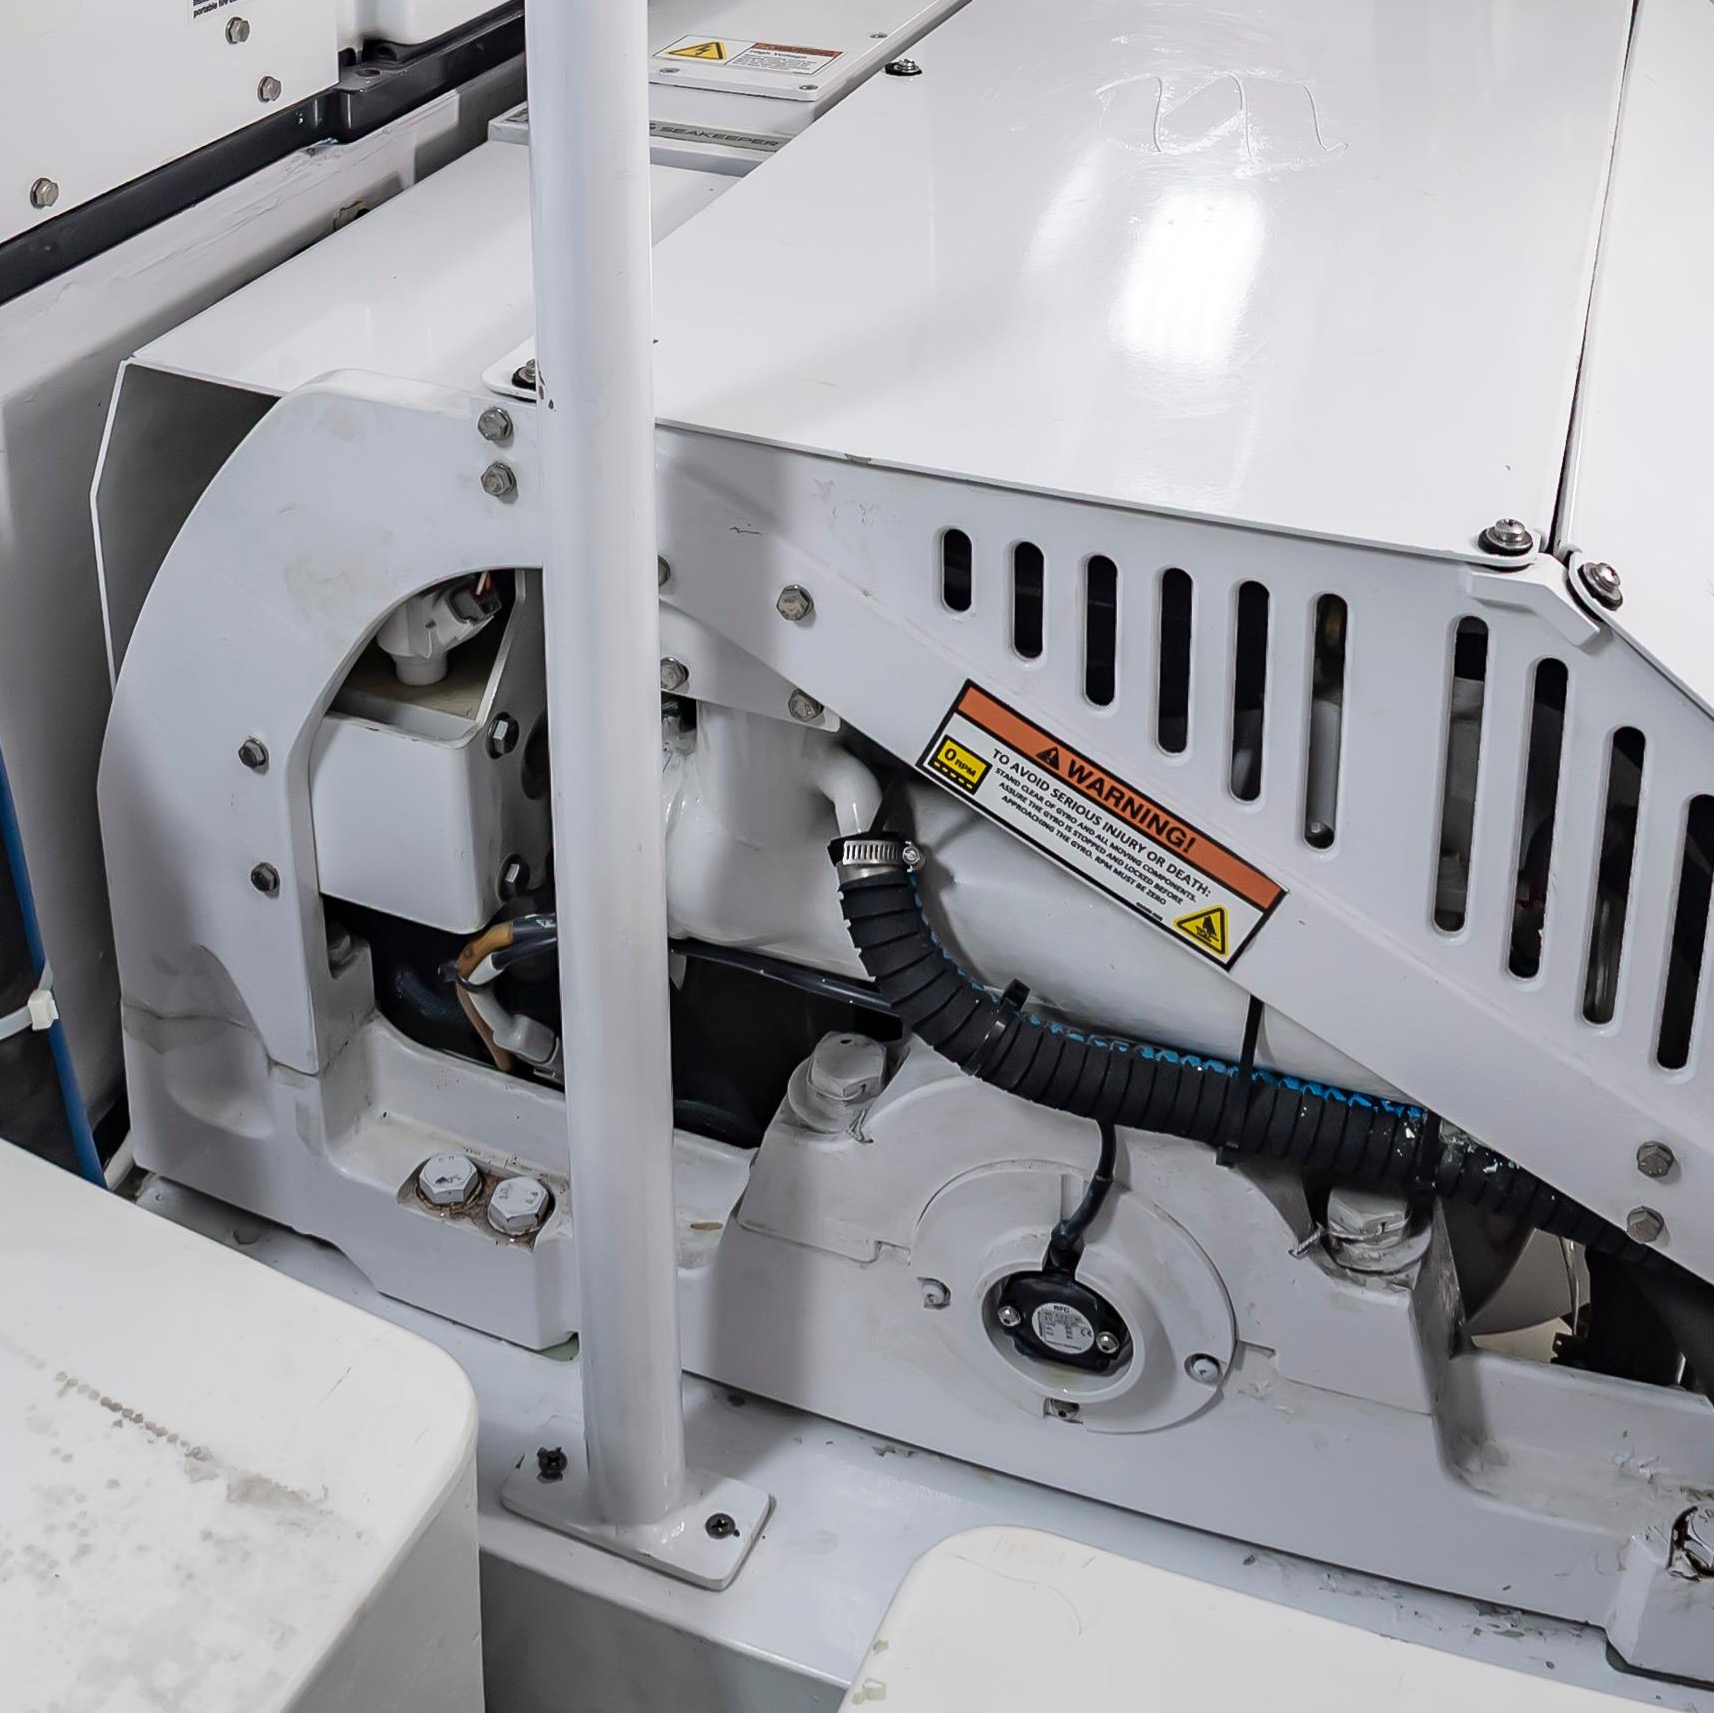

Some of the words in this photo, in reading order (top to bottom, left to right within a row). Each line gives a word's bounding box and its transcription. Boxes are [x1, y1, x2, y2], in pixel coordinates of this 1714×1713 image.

[193, 3, 217, 19] portable
[219, 0, 228, 7] fire
[660, 127, 779, 146] SEAKEEPER
[944, 748, 958, 762] 0
[954, 758, 978, 778] RPM
[1067, 758, 1196, 855] WARNING!
[992, 748, 1011, 766] TO
[1010, 762, 1051, 793] AVOID
[1050, 787, 1103, 827] SERIOUS
[1102, 821, 1148, 855] INJURY
[1146, 850, 1166, 868] OR
[1165, 863, 1212, 898] DEATH:
[994, 767, 1022, 787] STAND
[1020, 783, 1046, 803] CLEAR
[1044, 798, 1057, 810] OF
[1055, 807, 1078, 824] GYRO
[1077, 821, 1096, 836] AND
[1095, 832, 1110, 846] ALL
[1109, 841, 1143, 868] MOVING
[1141, 863, 1197, 903] COMPONENTS.
[998, 782, 1028, 804] ASSURE
[1027, 800, 1043, 815] THE
[1042, 810, 1066, 828] GYRO
[1064, 823, 1074, 833] IS
[1072, 829, 1107, 855] STOPPED
[1105, 852, 1125, 867] AND
[1123, 862, 1154, 887] LOCKED
[1152, 881, 1184, 906] BEFORE
[1000, 795, 1056, 833] APPROACHING
[1055, 829, 1072, 844] THE
[1093, 855, 1114, 872] RPM
[1112, 866, 1137, 886] MUST
[1135, 882, 1146, 894] BE
[1145, 888, 1168, 906] ZERO
